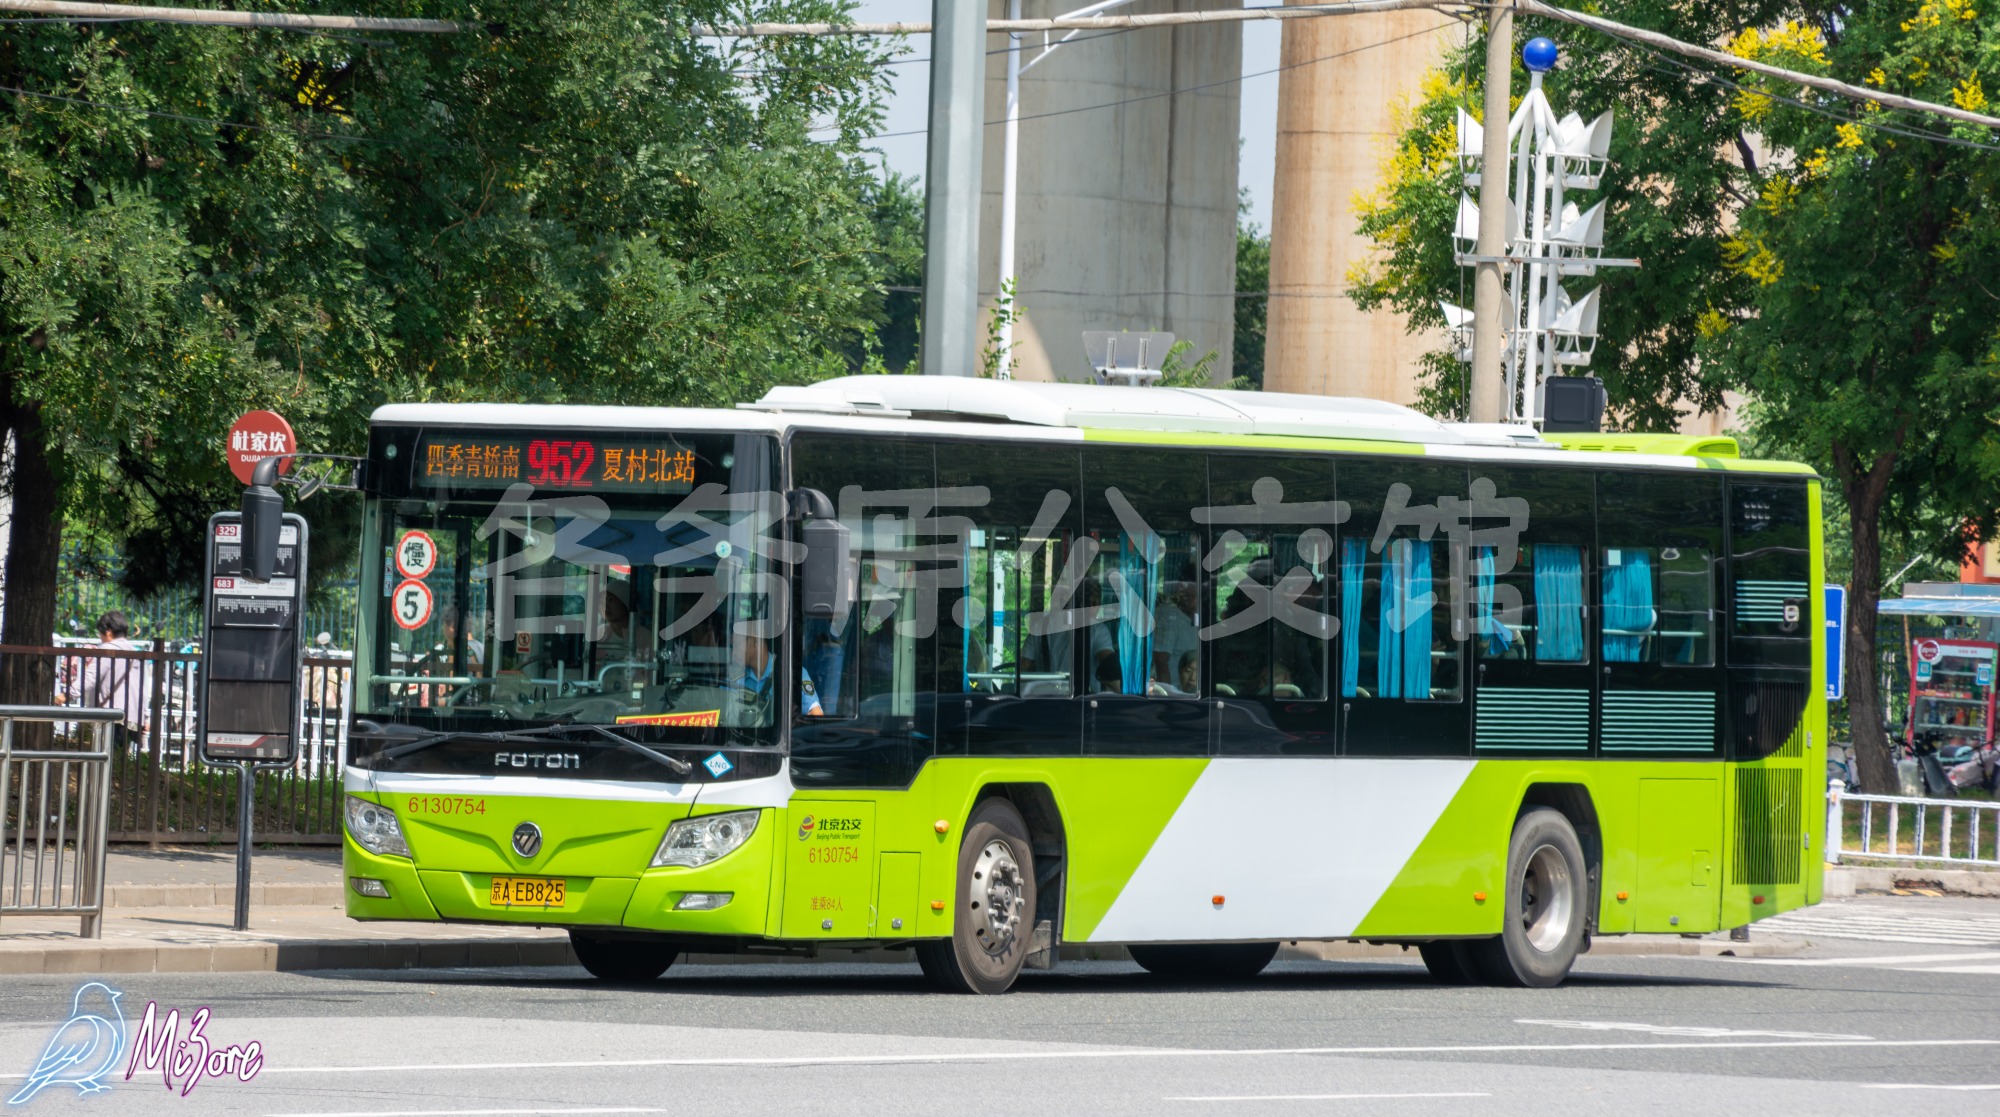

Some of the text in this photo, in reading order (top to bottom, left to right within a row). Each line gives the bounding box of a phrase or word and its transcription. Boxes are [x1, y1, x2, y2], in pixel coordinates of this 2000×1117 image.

[232, 430, 287, 453] 杜家坎
[241, 454, 276, 462] DUJIA
[427, 440, 696, 487] 四季青桥南 952 夏村北站
[218, 526, 236, 536] 329
[404, 541, 425, 568] 慢
[216, 580, 232, 588] 683
[403, 590, 419, 620] 5
[494, 752, 580, 769] FOTON
[709, 760, 728, 770] LNG
[408, 796, 487, 815] 6130754
[817, 818, 862, 831] 北京公交
[816, 833, 830, 841] Beijing
[809, 846, 859, 864] 6130754
[811, 896, 843, 912] 准乘84人
